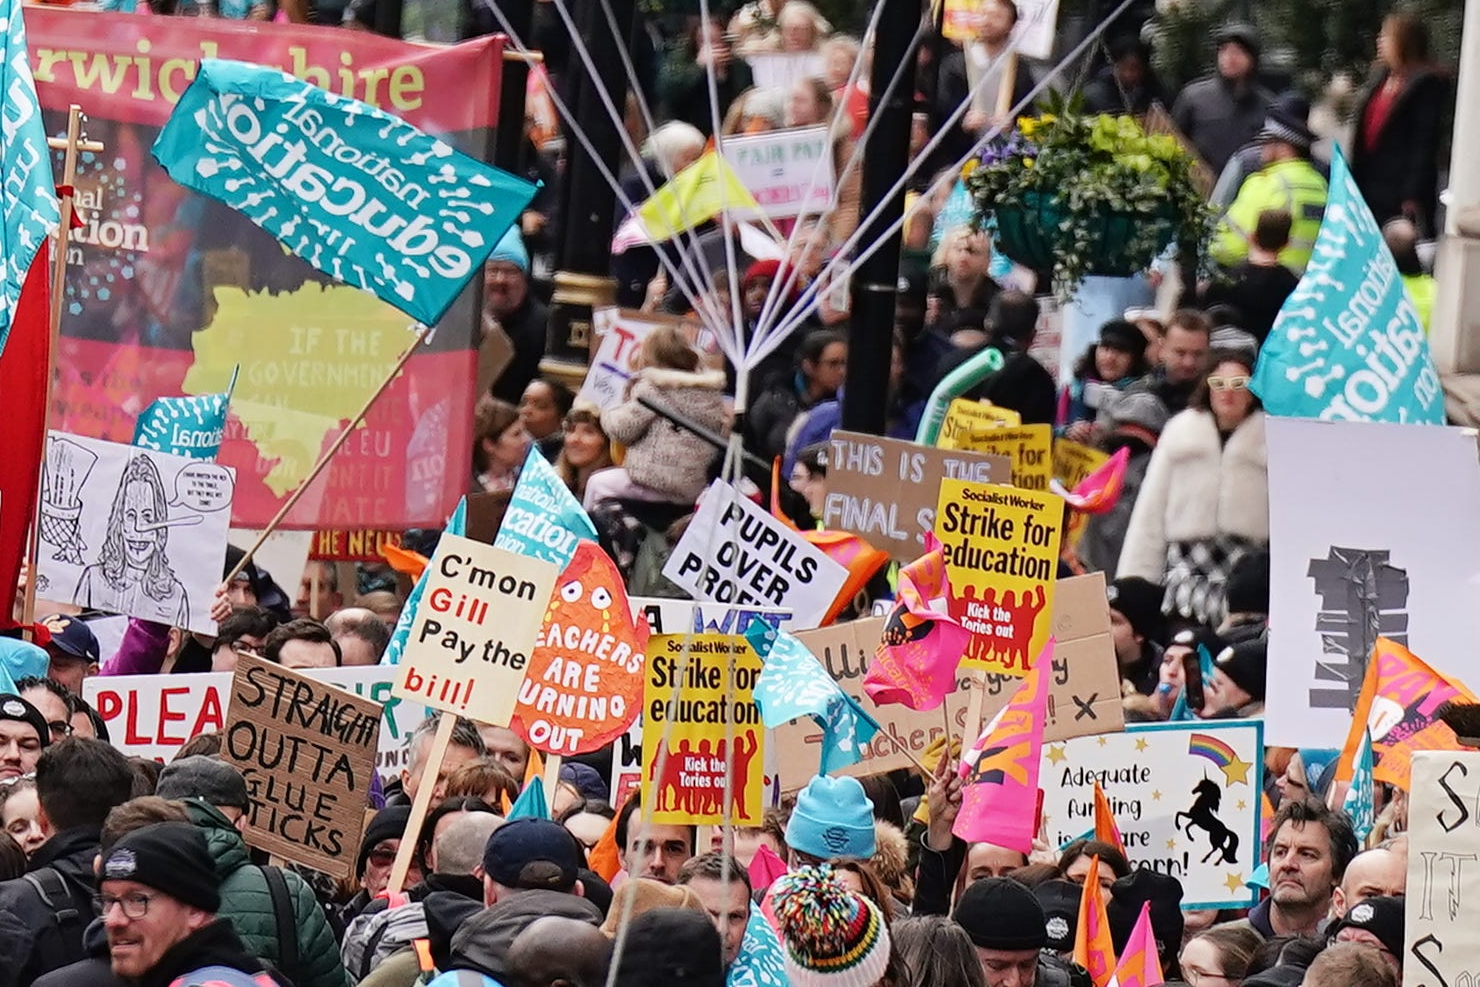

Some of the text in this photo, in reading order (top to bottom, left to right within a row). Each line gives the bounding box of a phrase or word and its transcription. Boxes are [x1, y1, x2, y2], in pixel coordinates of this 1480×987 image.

[831, 440, 885, 476] THIS
[899, 451, 926, 483] IS
[1018, 441, 1045, 466] for
[823, 493, 910, 541] FINAL
[962, 488, 1045, 511] Socialist Worker
[719, 501, 819, 584] PUPILS
[943, 502, 1014, 541] Strike
[1022, 513, 1056, 548] for
[440, 554, 537, 602] C'mon
[716, 540, 790, 607] OVER
[943, 539, 1051, 582] education
[429, 587, 489, 626] Gill
[961, 615, 1014, 639] Tories out
[967, 601, 1012, 624] Kick the
[419, 618, 527, 671] Pay the
[535, 623, 646, 675] EACHERS
[667, 640, 747, 655] Soalist Woer
[403, 666, 476, 711] bill!
[543, 656, 601, 694] ARE
[728, 659, 761, 690] or
[96, 686, 224, 746] PLEA
[237, 666, 381, 748] STRAIGHT
[518, 679, 627, 722] URNING
[650, 695, 759, 724] eucaton
[227, 720, 356, 792] OUTTA
[528, 718, 585, 753] OUT
[679, 771, 728, 788] Tories ou
[684, 756, 709, 772] Kick
[1061, 764, 1150, 790] Adequate
[241, 768, 337, 823] GLUE
[1068, 796, 1142, 821] fuing
[248, 799, 344, 858] TICKS
[1121, 831, 1150, 846] are
[1420, 852, 1478, 921] IT
